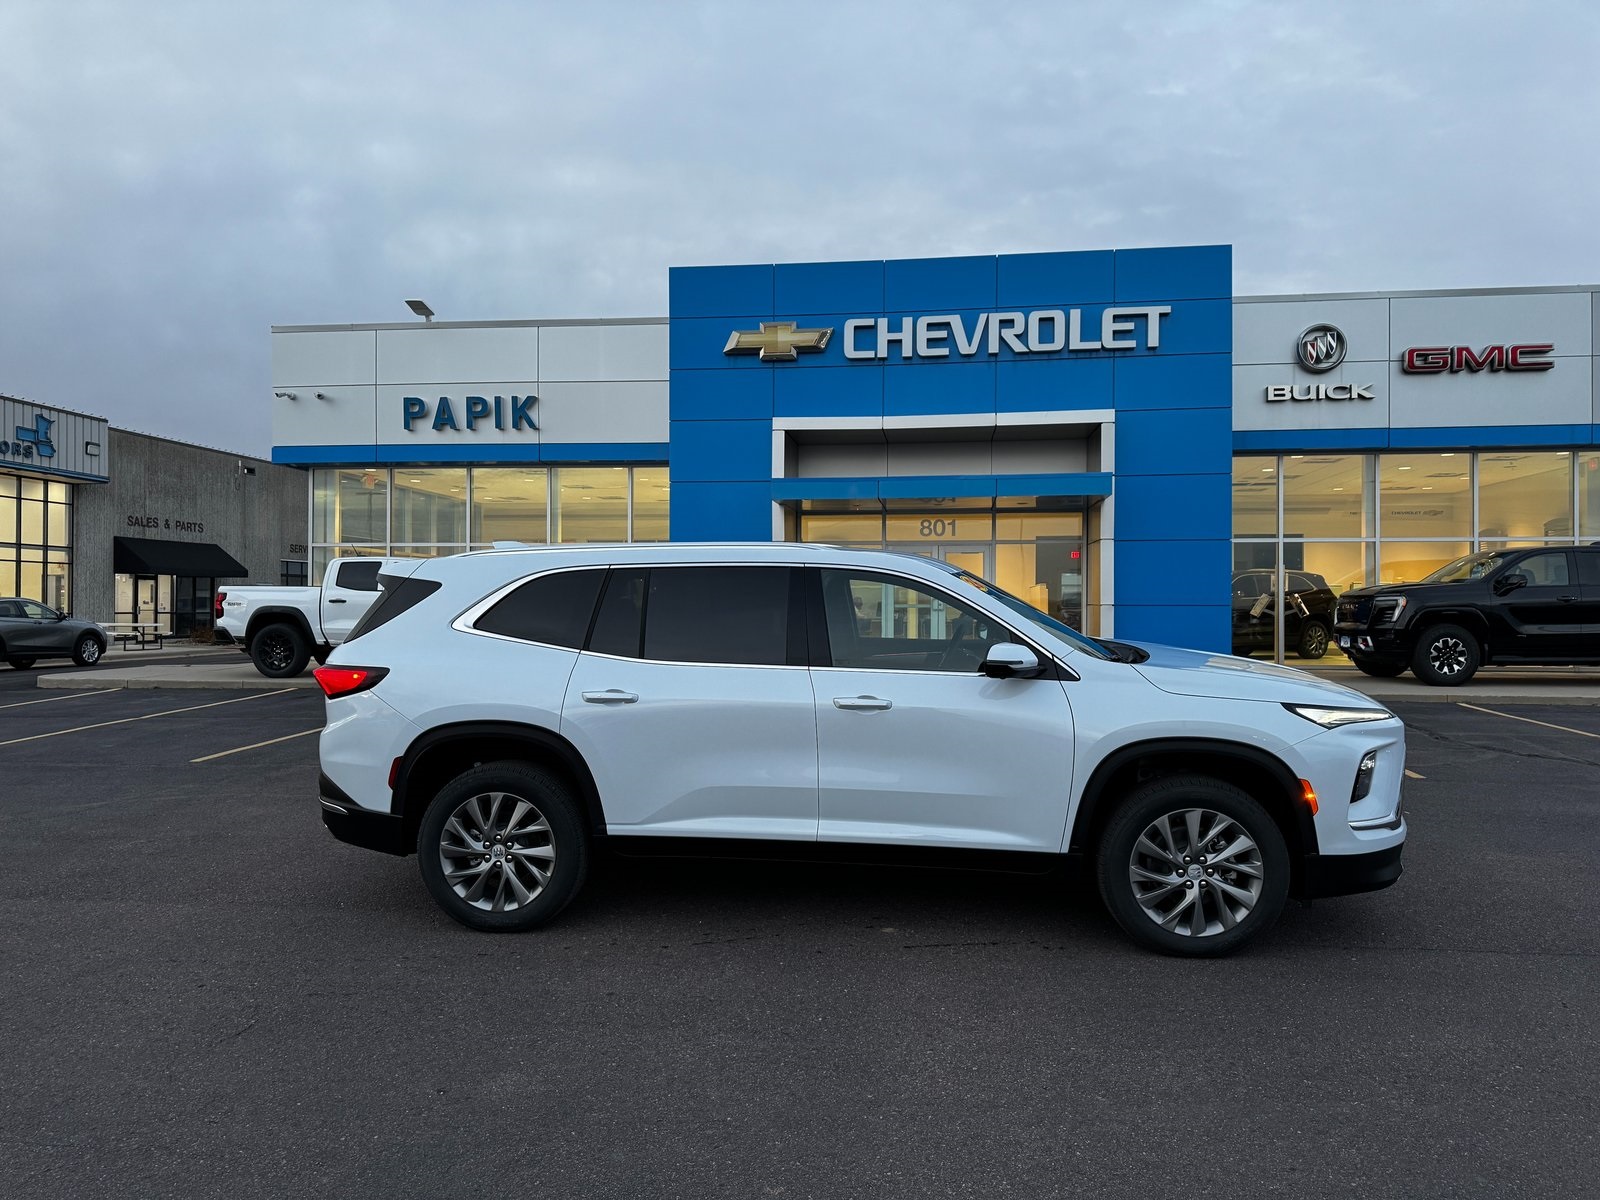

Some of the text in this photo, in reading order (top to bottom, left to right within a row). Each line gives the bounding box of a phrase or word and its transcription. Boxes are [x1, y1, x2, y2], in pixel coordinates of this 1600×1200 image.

[843, 305, 1172, 360] CHEVROLET
[1402, 343, 1555, 374] GMC
[1266, 384, 1376, 402] BUICK
[403, 395, 539, 431] PAPIK
[126, 515, 204, 533] SALES & PARTS
[919, 518, 956, 537] 801
